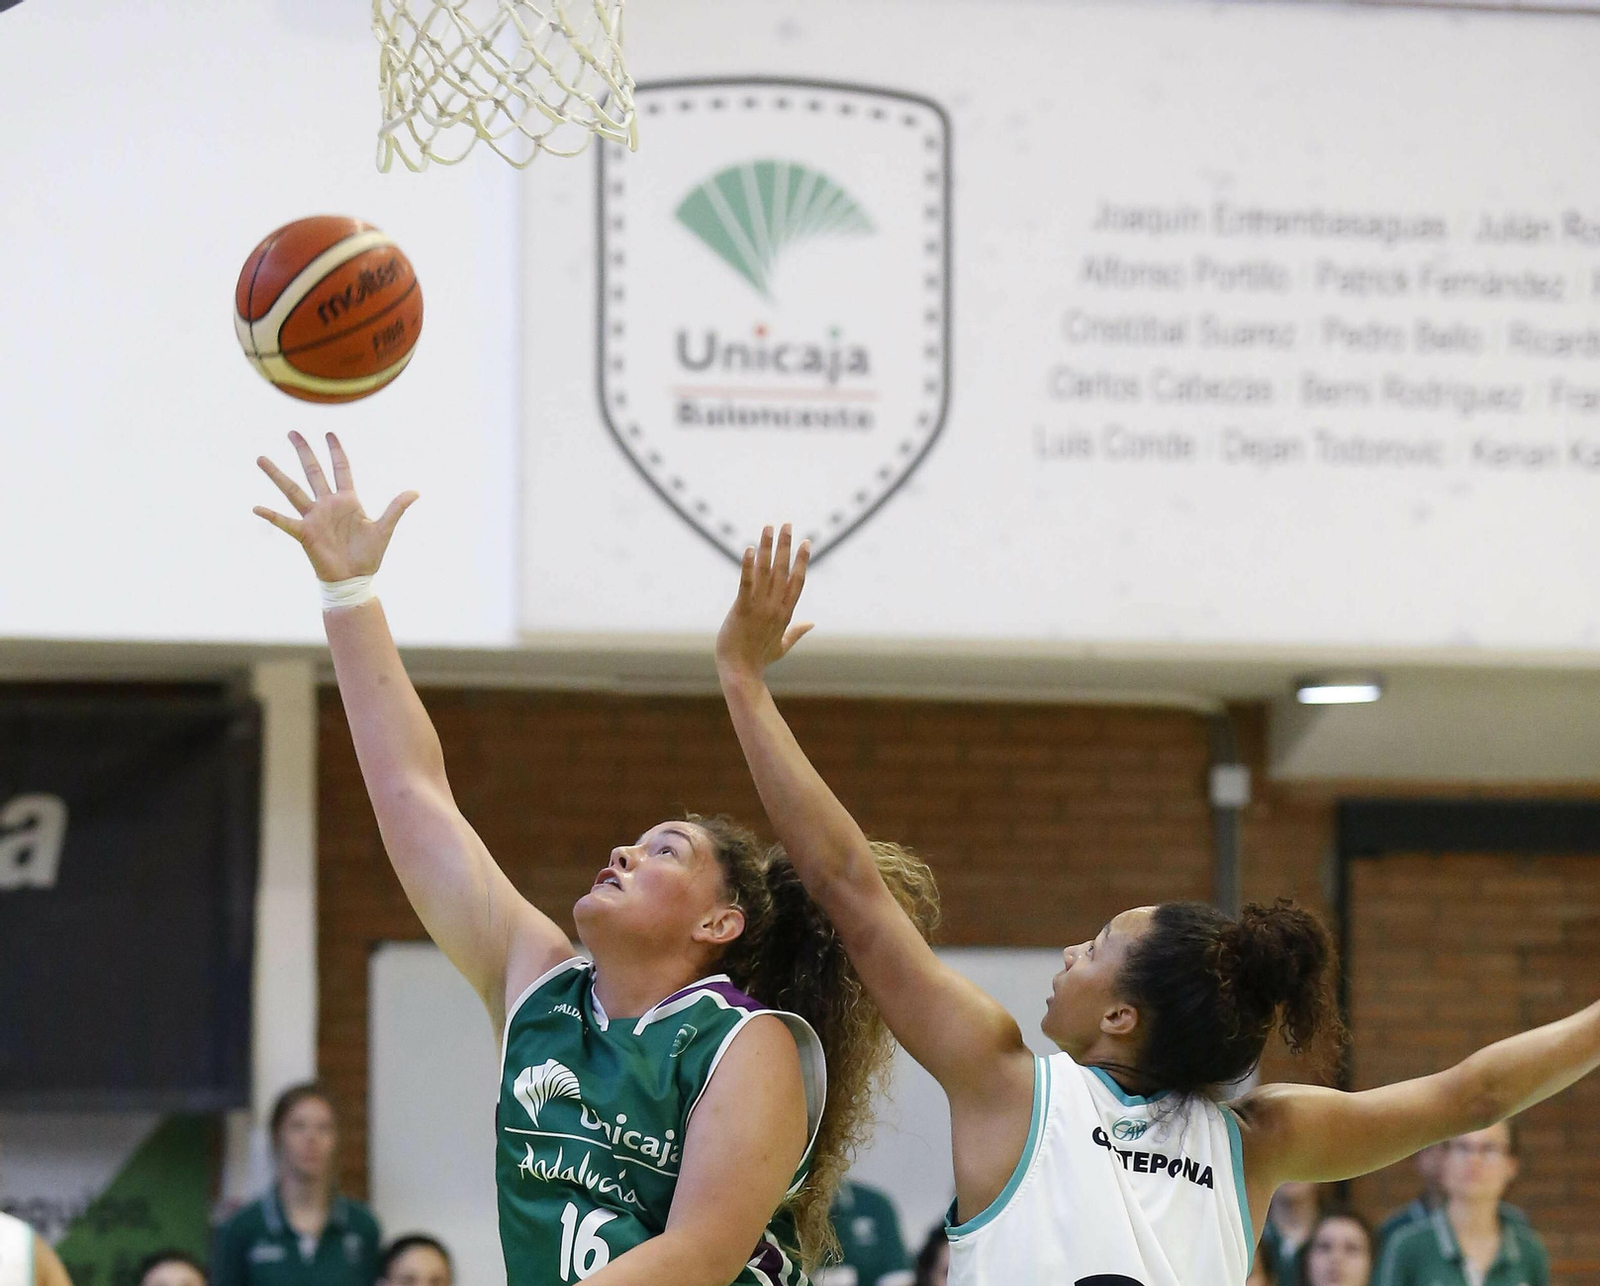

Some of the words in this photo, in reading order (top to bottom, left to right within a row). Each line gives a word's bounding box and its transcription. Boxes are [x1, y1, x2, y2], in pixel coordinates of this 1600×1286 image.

[677, 325, 871, 384] Unicaja
[518, 1142, 647, 1211] Andalucía
[560, 1202, 617, 1282] 16
